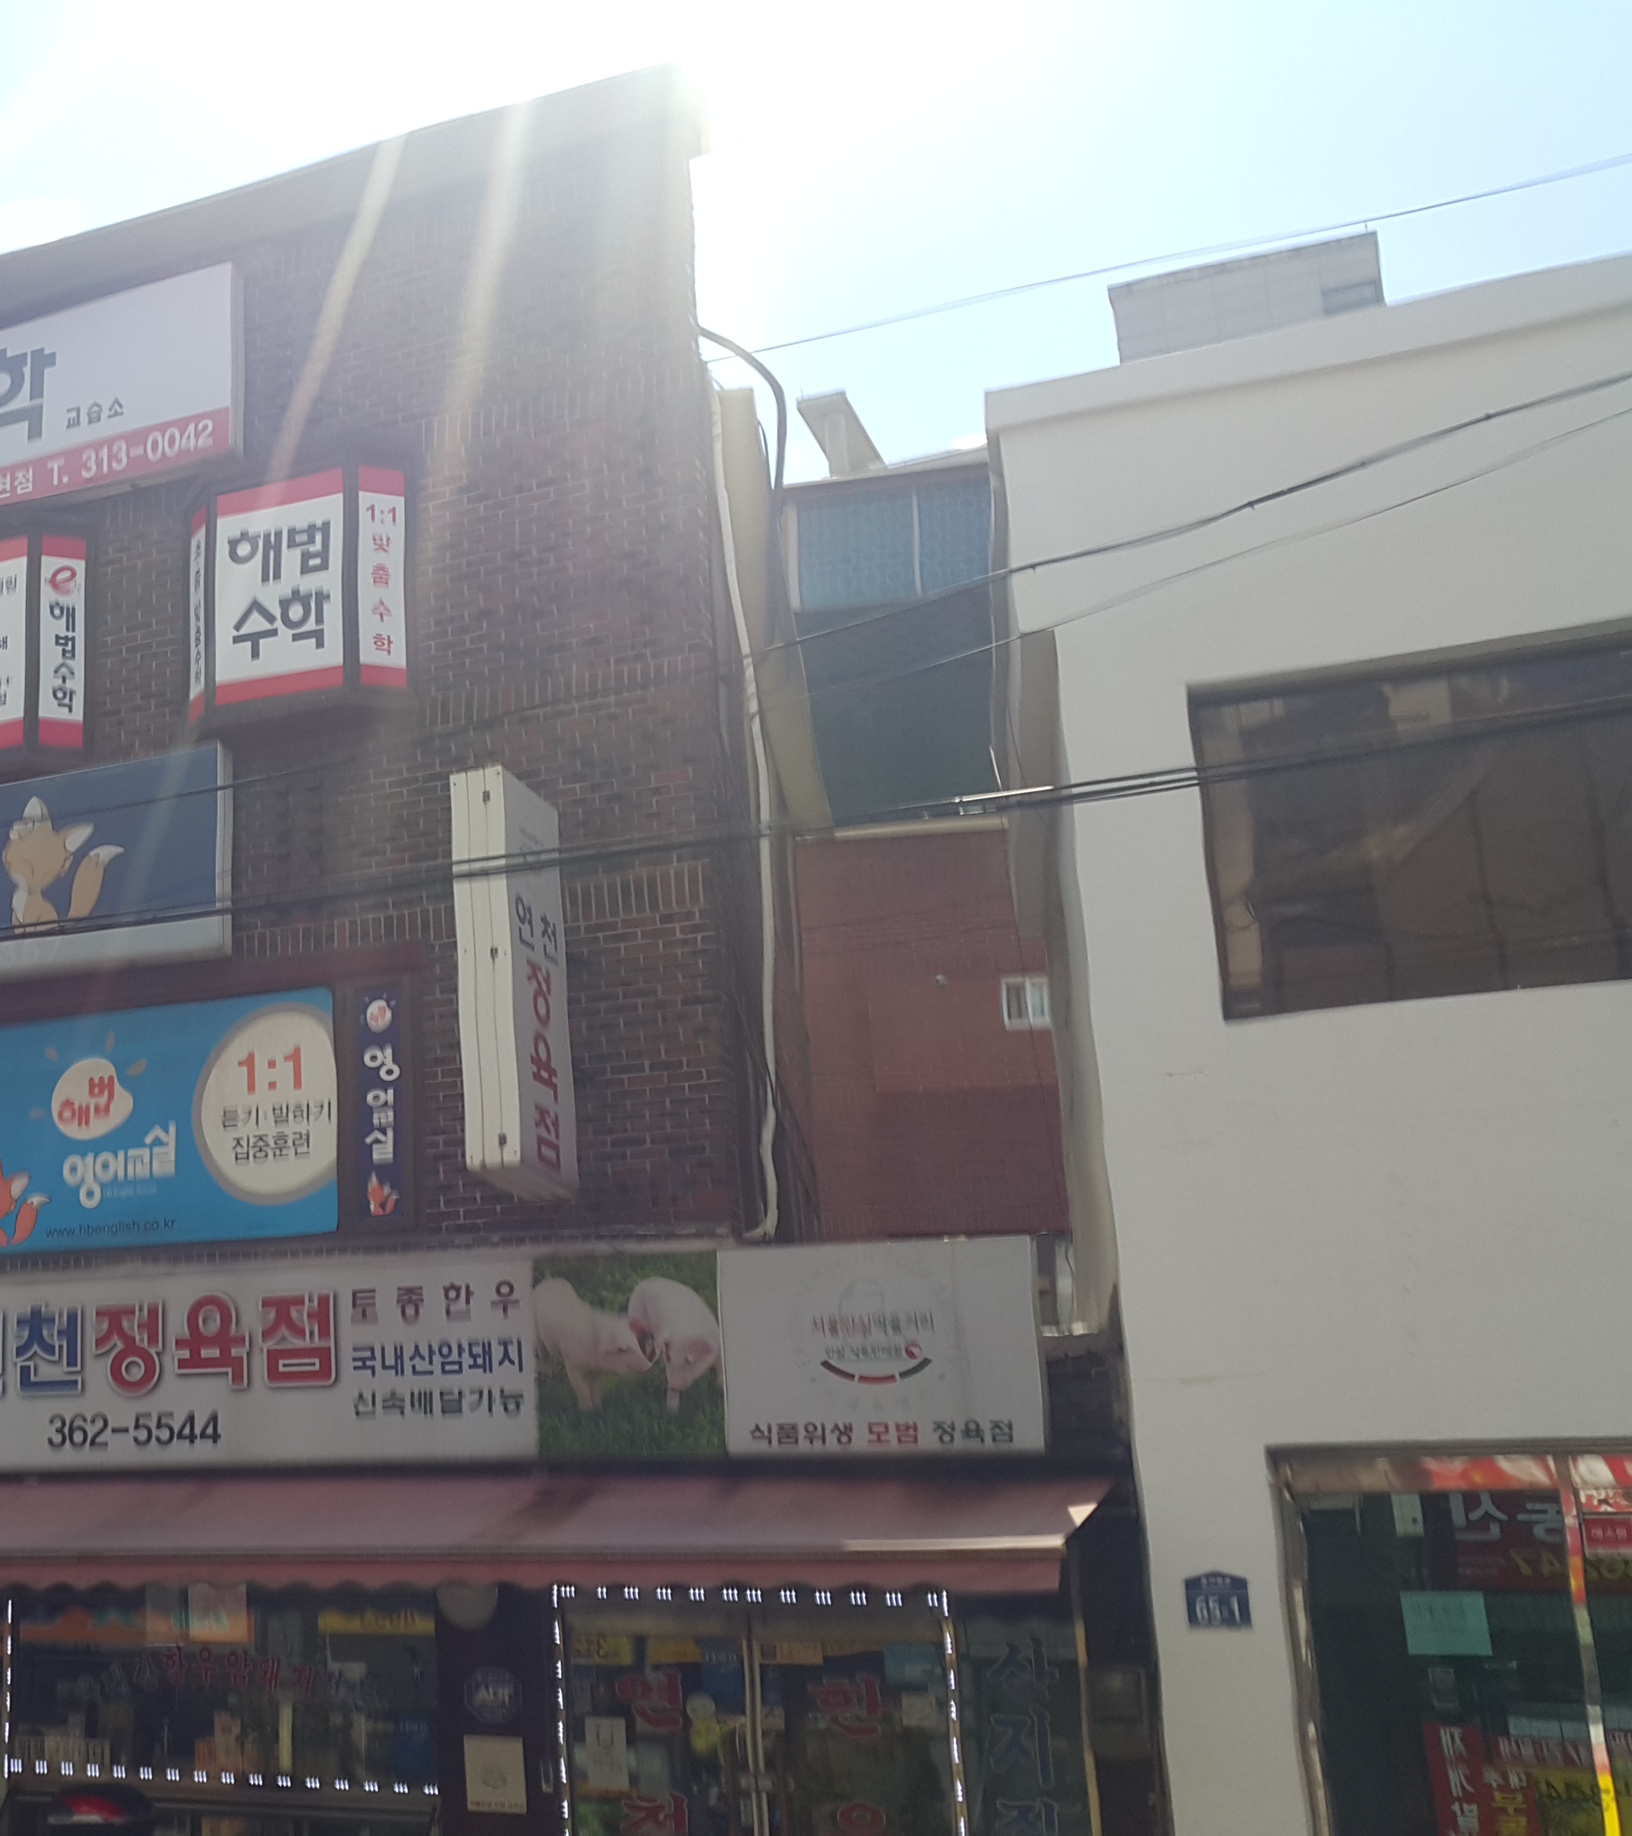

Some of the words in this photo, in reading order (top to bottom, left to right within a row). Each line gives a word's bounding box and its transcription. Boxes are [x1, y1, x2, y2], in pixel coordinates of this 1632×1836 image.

[66, 396, 125, 430] 교습소
[81, 418, 215, 480] 313-0042
[367, 503, 397, 526] 1:1
[228, 518, 332, 587] 해법
[232, 584, 332, 663] 수학
[49, 598, 78, 714] 해법수학
[236, 1043, 304, 1098] 1:1
[56, 1073, 116, 1130] 해법
[362, 1043, 402, 1166] 영어교실
[62, 1120, 178, 1211] 영어교실
[231, 1129, 312, 1165] 집중훈련
[351, 1338, 526, 1379] 국내산암돼지
[46, 1409, 223, 1450] 362-5544
[749, 1420, 854, 1447] 식품위생
[868, 1420, 920, 1446] 모범
[932, 1418, 1015, 1446] 정육점
